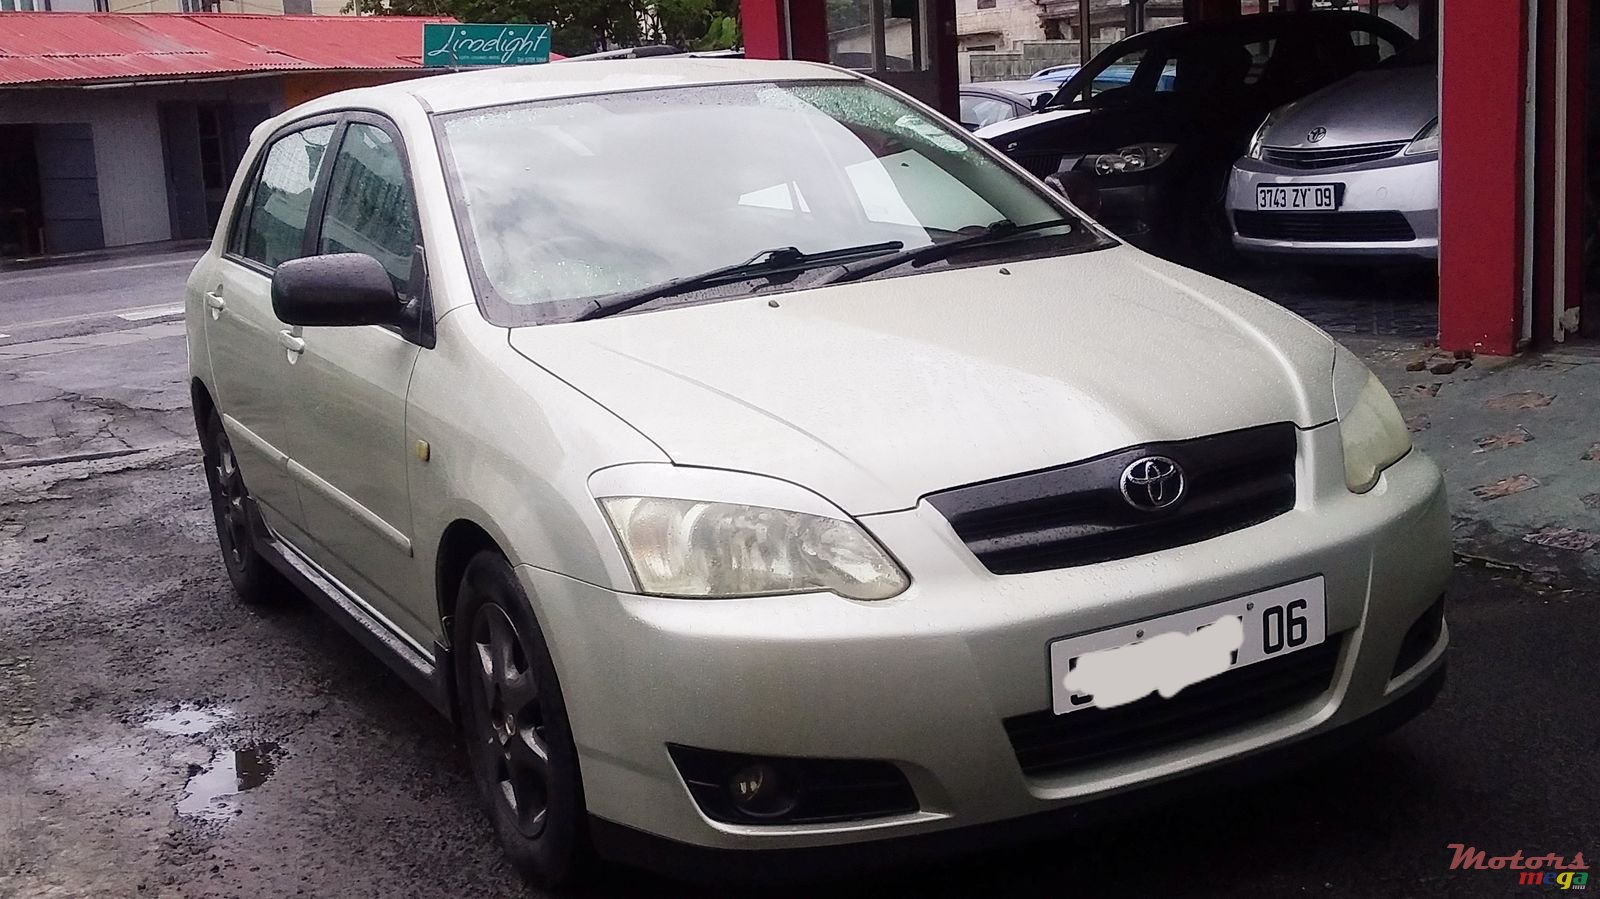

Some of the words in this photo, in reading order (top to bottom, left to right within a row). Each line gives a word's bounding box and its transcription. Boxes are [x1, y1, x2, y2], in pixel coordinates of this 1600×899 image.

[427, 27, 548, 64] Limelight
[1259, 188, 1287, 208] 3743
[1292, 188, 1308, 208] ZY
[1315, 187, 1332, 207] 09
[1262, 598, 1308, 655] 06
